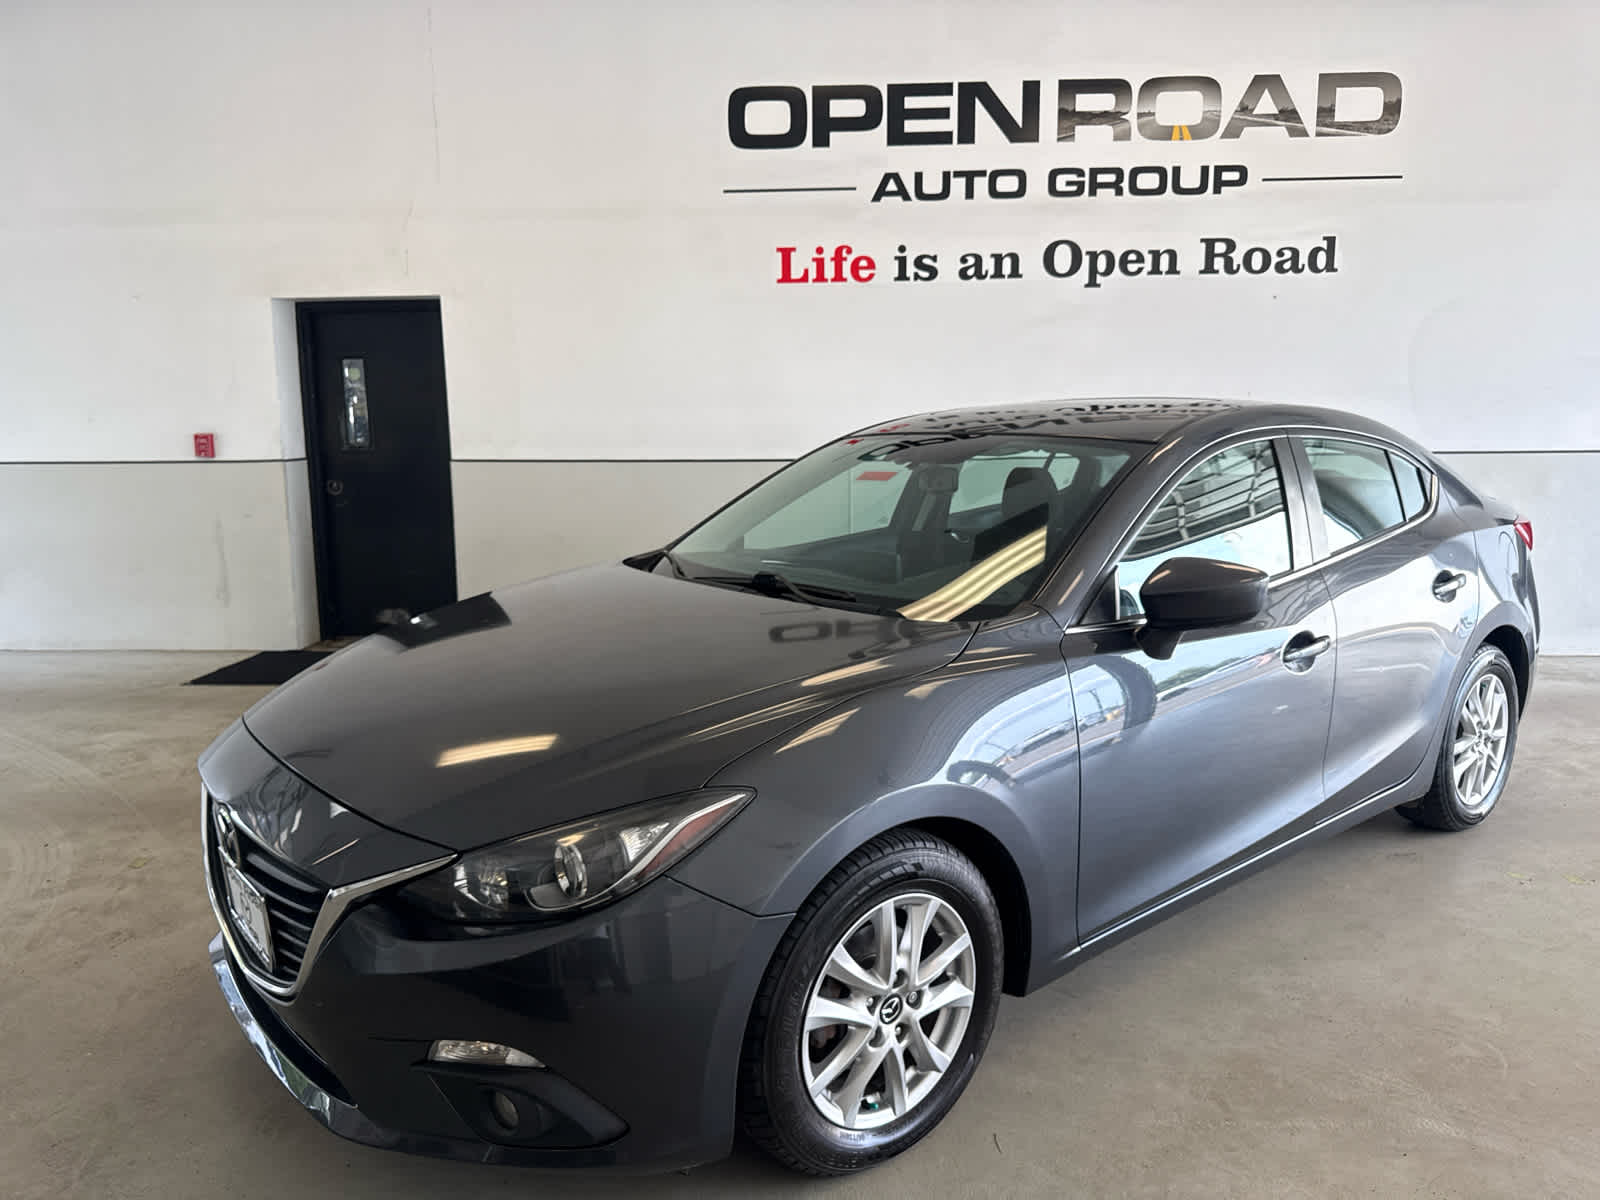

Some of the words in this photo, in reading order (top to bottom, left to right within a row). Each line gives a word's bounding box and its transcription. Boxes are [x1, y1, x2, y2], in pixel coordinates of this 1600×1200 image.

[727, 79, 1041, 150] OPEN
[1056, 71, 1403, 143] ROAD
[871, 168, 1027, 203] AUTO
[1047, 164, 1249, 198] GROUP
[775, 244, 877, 284] Life
[893, 244, 939, 282] is
[958, 252, 1023, 281] an
[1042, 239, 1181, 289] Open
[1198, 235, 1338, 275] Road
